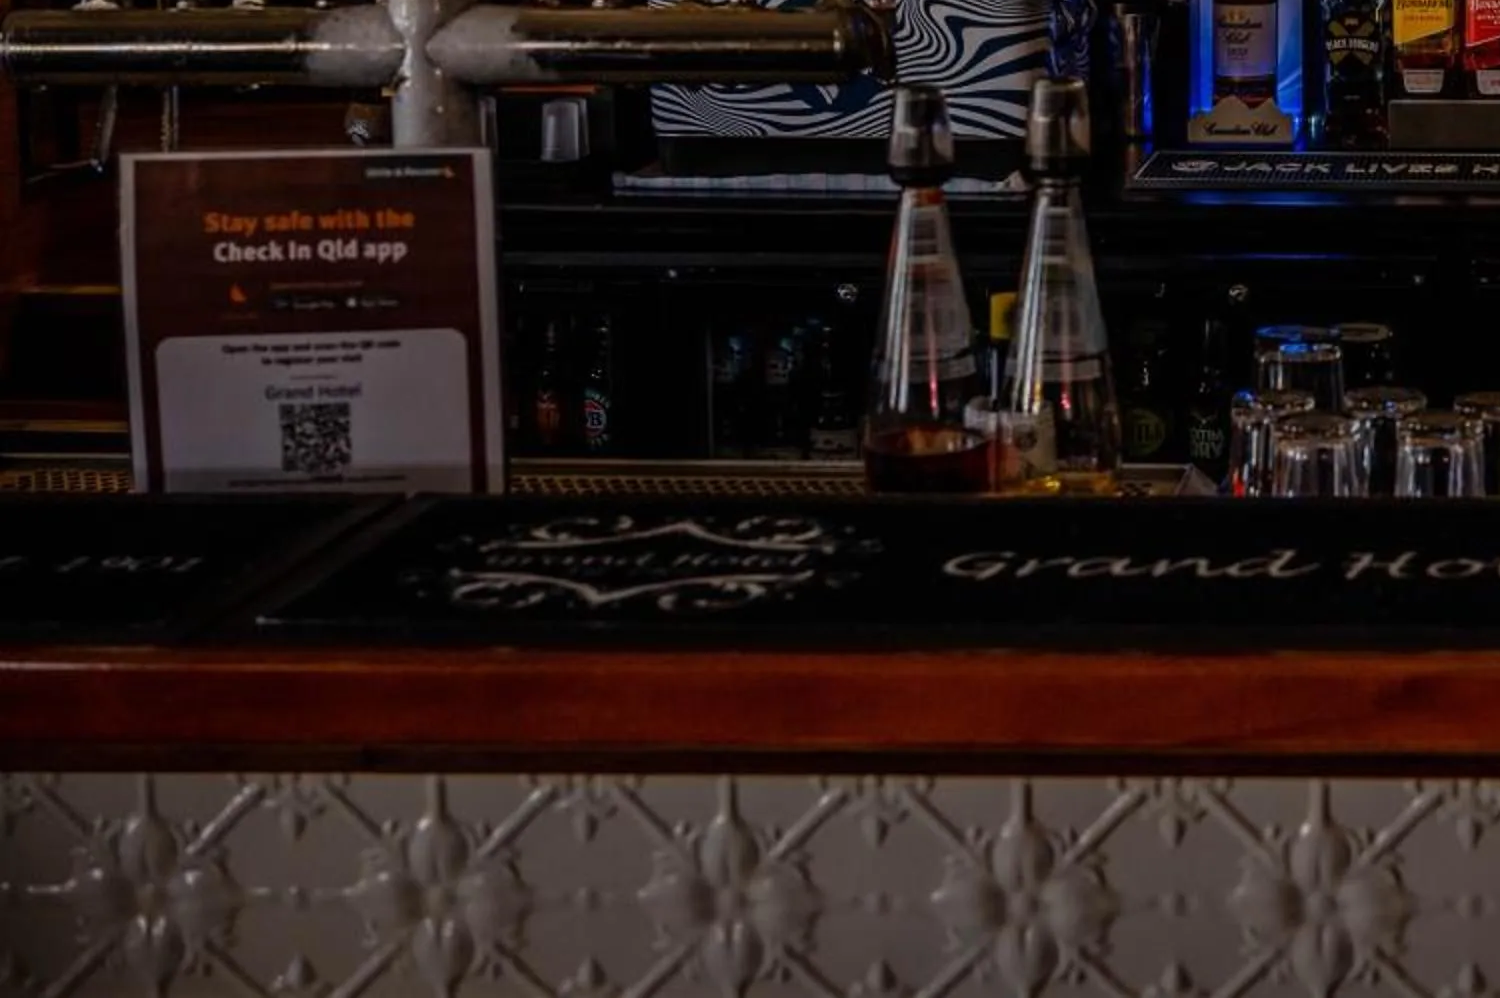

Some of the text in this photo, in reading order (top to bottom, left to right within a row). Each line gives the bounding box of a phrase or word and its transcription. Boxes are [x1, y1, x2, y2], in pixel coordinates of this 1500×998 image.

[1224, 161, 1332, 176] JACK
[1345, 161, 1460, 176] LIVES
[203, 207, 415, 238] Stay safe with the
[213, 240, 284, 263] Check
[317, 238, 357, 263] Qld
[362, 242, 408, 265] app
[252, 343, 268, 353] the
[270, 343, 289, 355] app
[265, 382, 362, 401] Grand Hotel
[940, 548, 1322, 583] Grand
